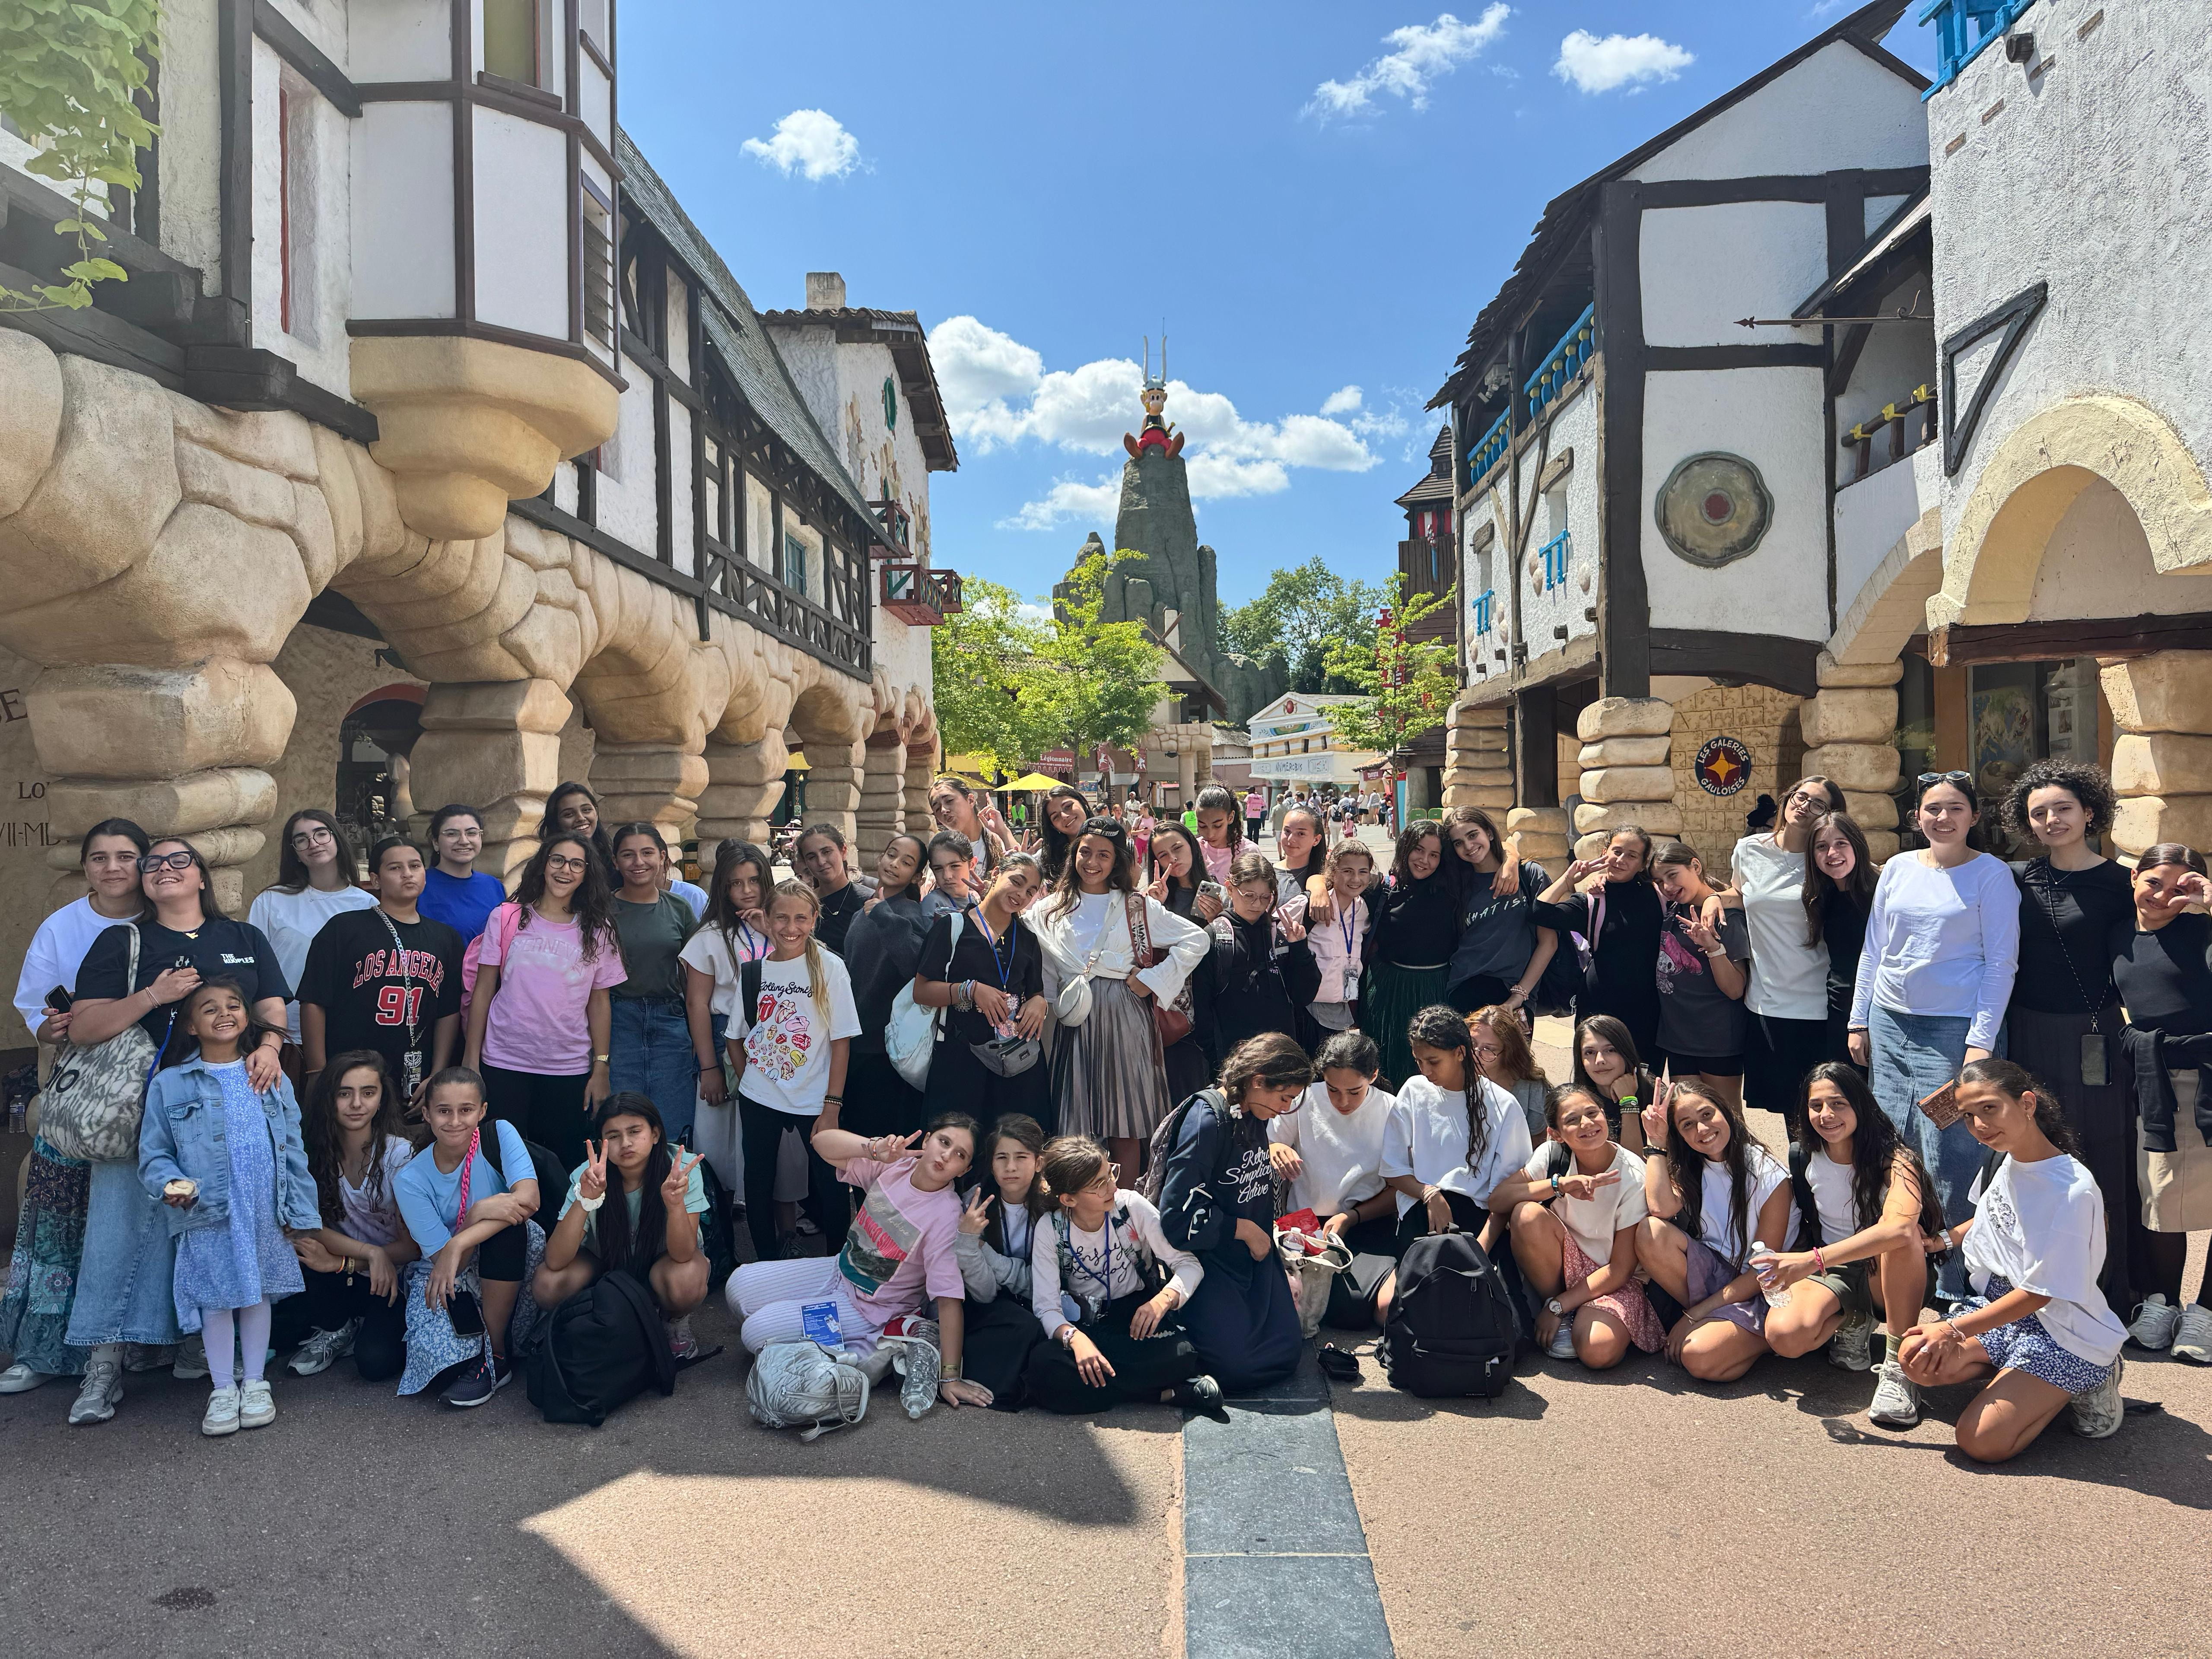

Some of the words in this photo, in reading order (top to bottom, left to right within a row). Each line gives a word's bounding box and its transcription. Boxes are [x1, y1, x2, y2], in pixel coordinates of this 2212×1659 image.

[1039, 753, 1072, 762] Légionnaire
[1697, 746, 1710, 764] LES
[18, 782, 50, 799] LO
[1701, 776, 1745, 795] GAULOISES
[1465, 902, 1500, 926] WHAT
[353, 949, 386, 989] LOS
[759, 981, 787, 998] Rolling
[784, 982, 815, 998] Stones
[375, 985, 424, 1026] 91
[1218, 1162, 1273, 1186] Simplici
[1237, 1182, 1268, 1204] Active
